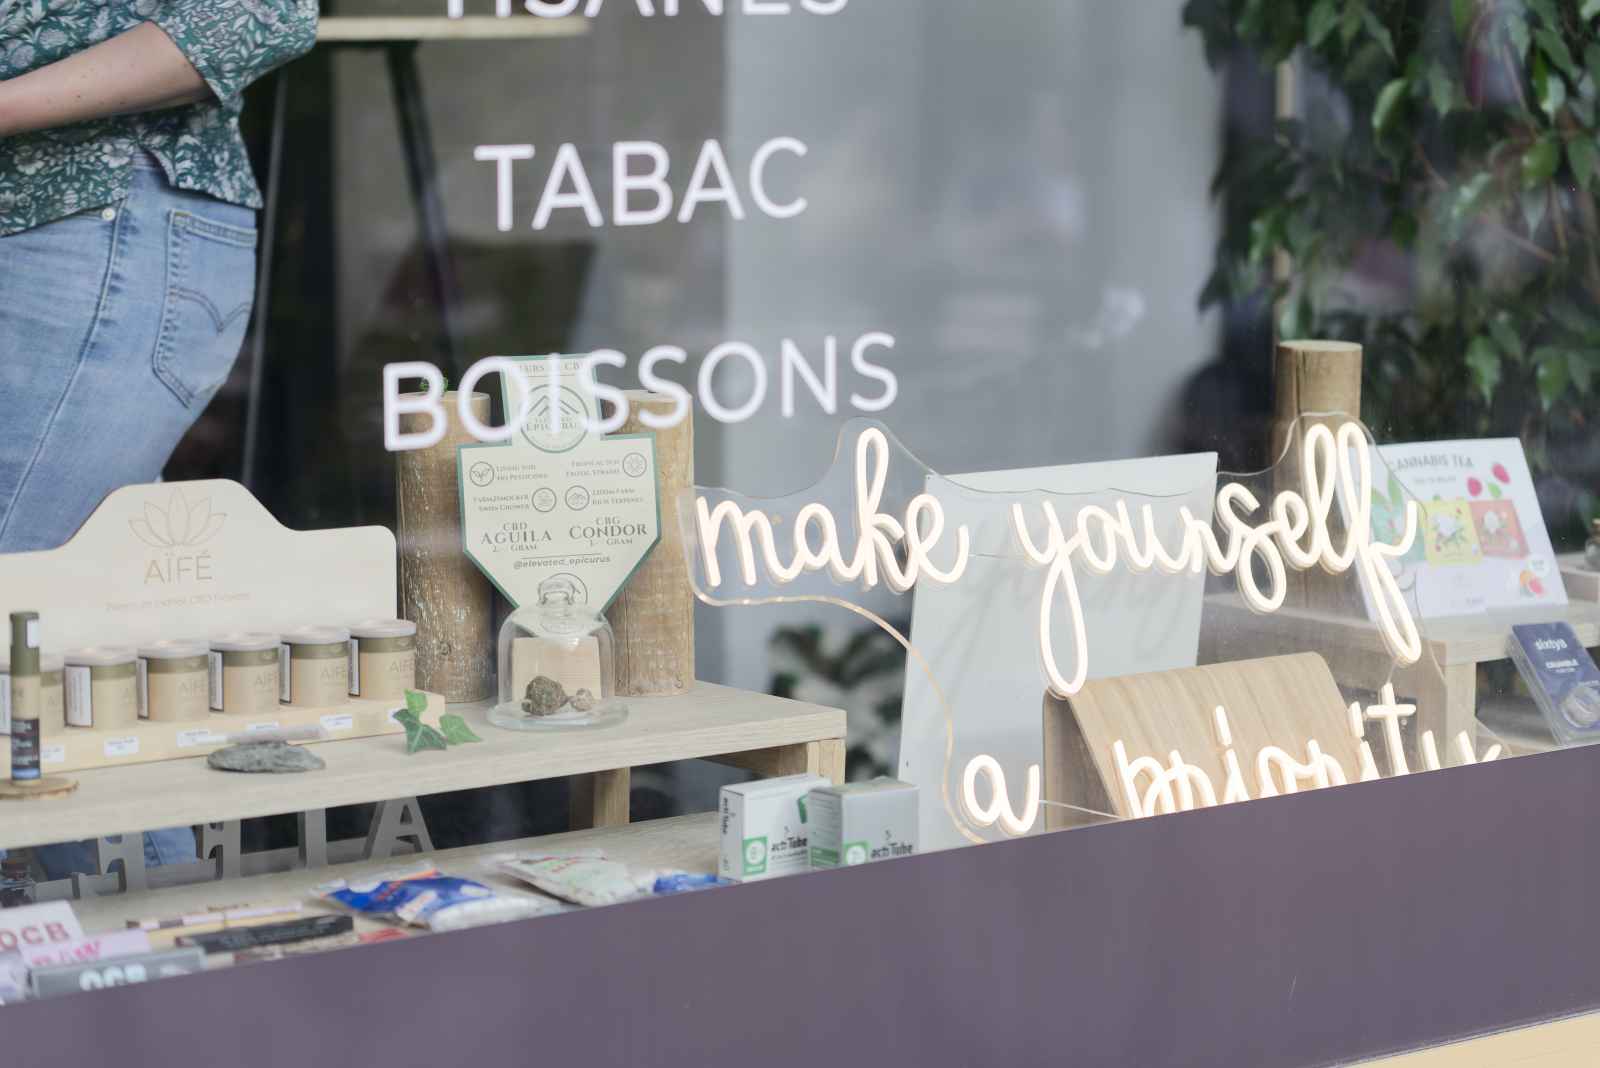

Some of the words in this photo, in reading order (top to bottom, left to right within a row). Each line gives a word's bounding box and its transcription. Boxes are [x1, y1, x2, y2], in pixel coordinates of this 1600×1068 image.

[474, 136, 808, 231] TABAC
[383, 331, 898, 451] BOISSONS
[481, 530, 552, 544] AGUILA
[569, 523, 648, 539] CONDOR
[695, 427, 969, 591] make
[1012, 422, 1421, 697] yourself
[962, 754, 1040, 834] a
